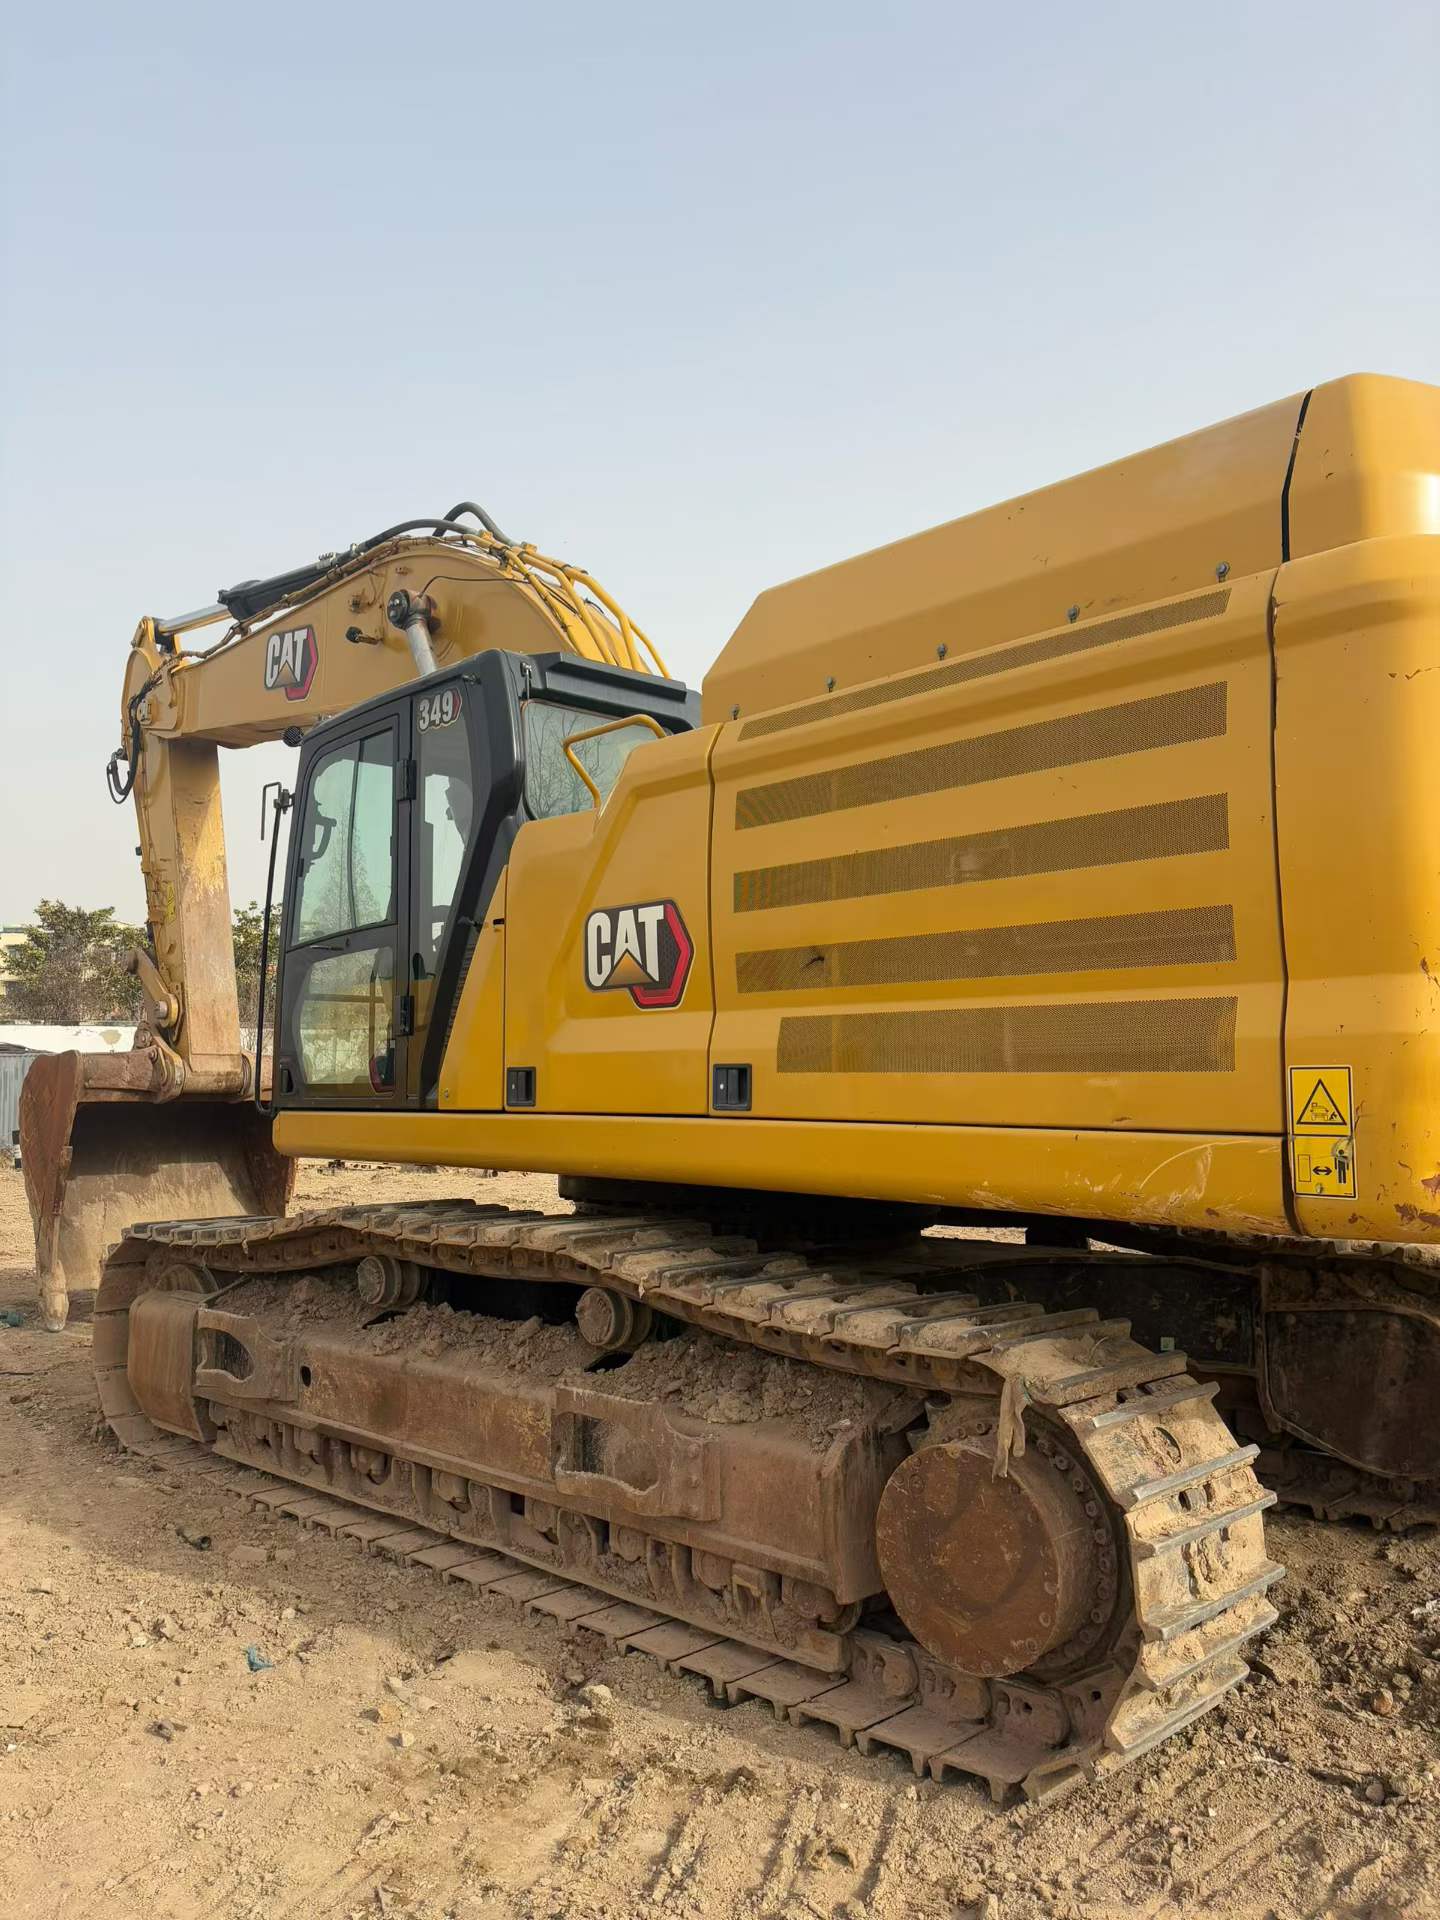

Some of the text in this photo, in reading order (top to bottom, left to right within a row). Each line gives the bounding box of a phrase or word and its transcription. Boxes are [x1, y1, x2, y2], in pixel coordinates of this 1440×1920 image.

[265, 627, 308, 688] CAT
[419, 690, 454, 730] 349
[587, 904, 665, 987] CAT
